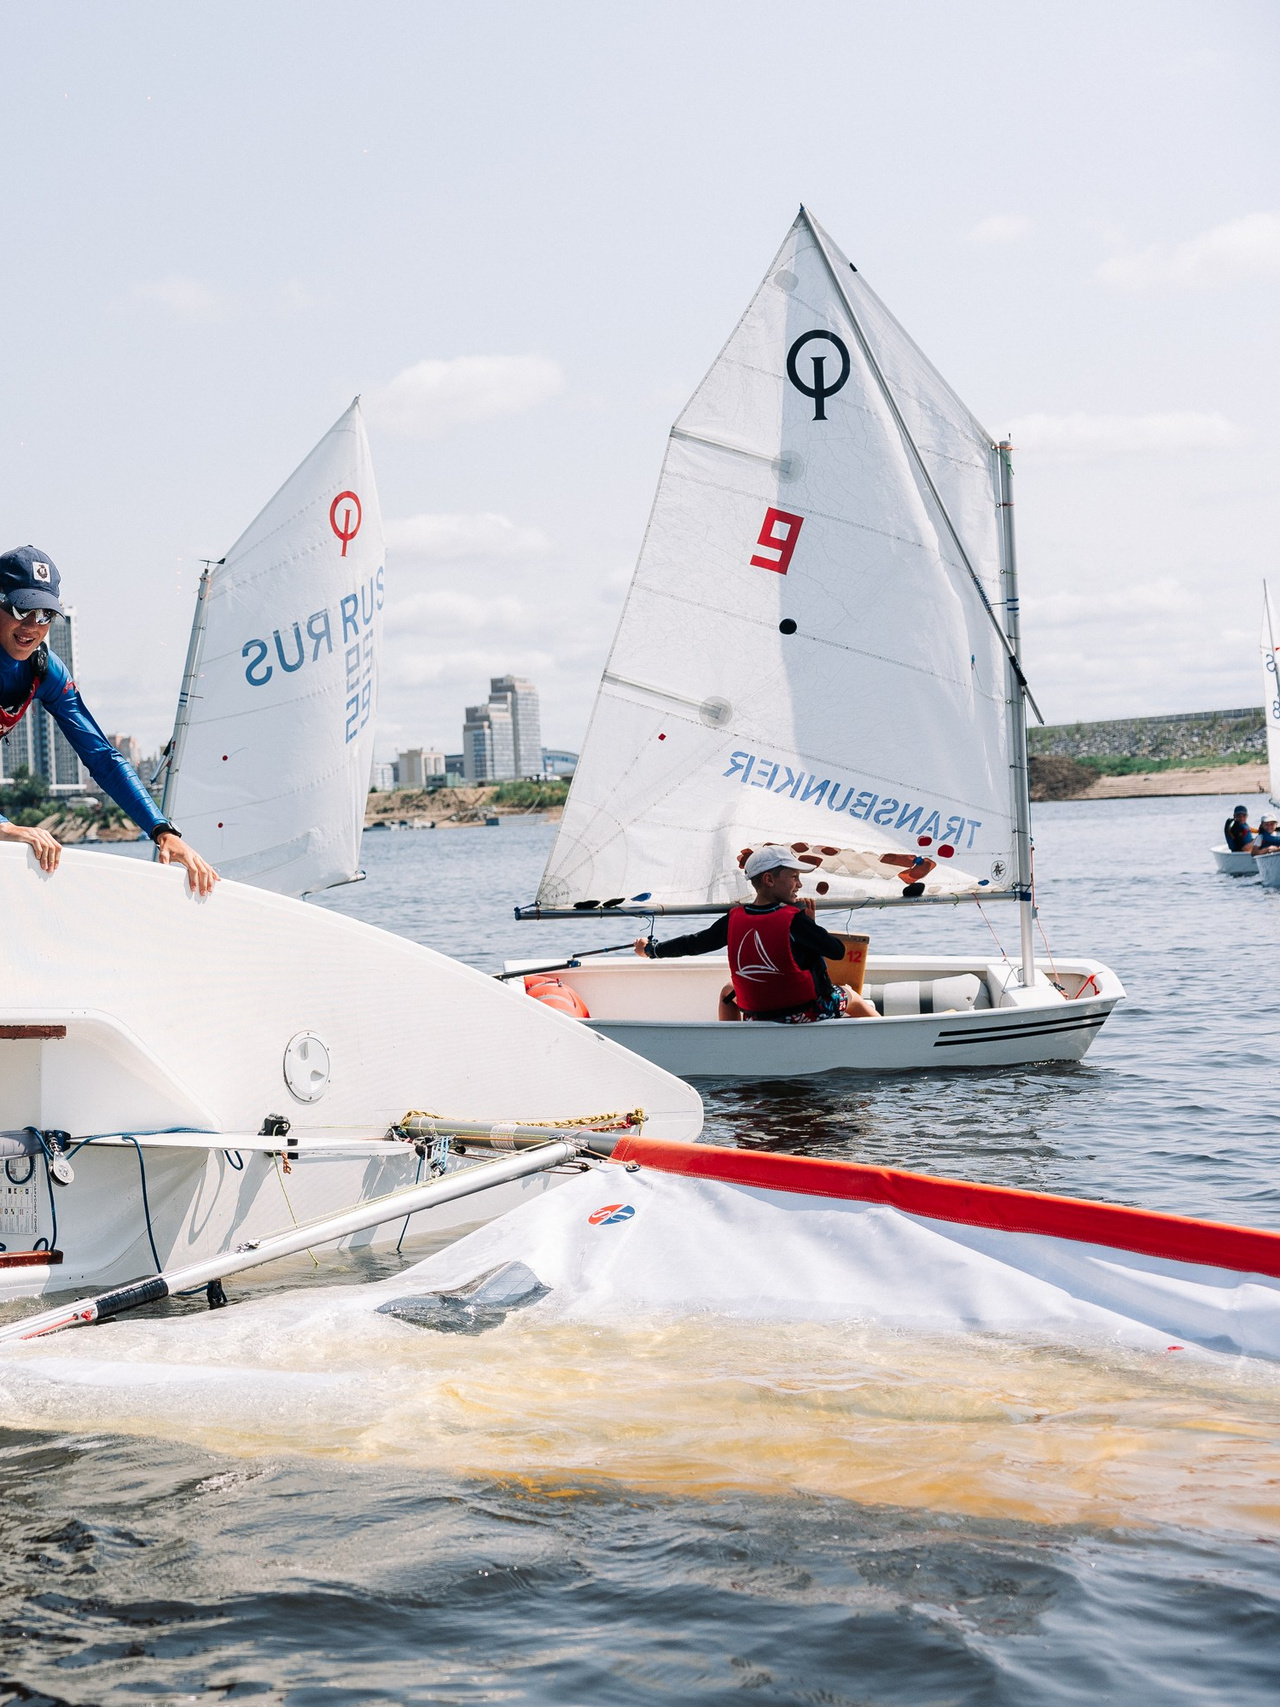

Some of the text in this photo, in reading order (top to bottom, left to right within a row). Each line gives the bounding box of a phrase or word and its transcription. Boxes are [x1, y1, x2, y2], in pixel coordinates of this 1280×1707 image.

[750, 507, 804, 575] 9
[340, 566, 384, 643] RUS
[846, 950, 862, 963] 12
